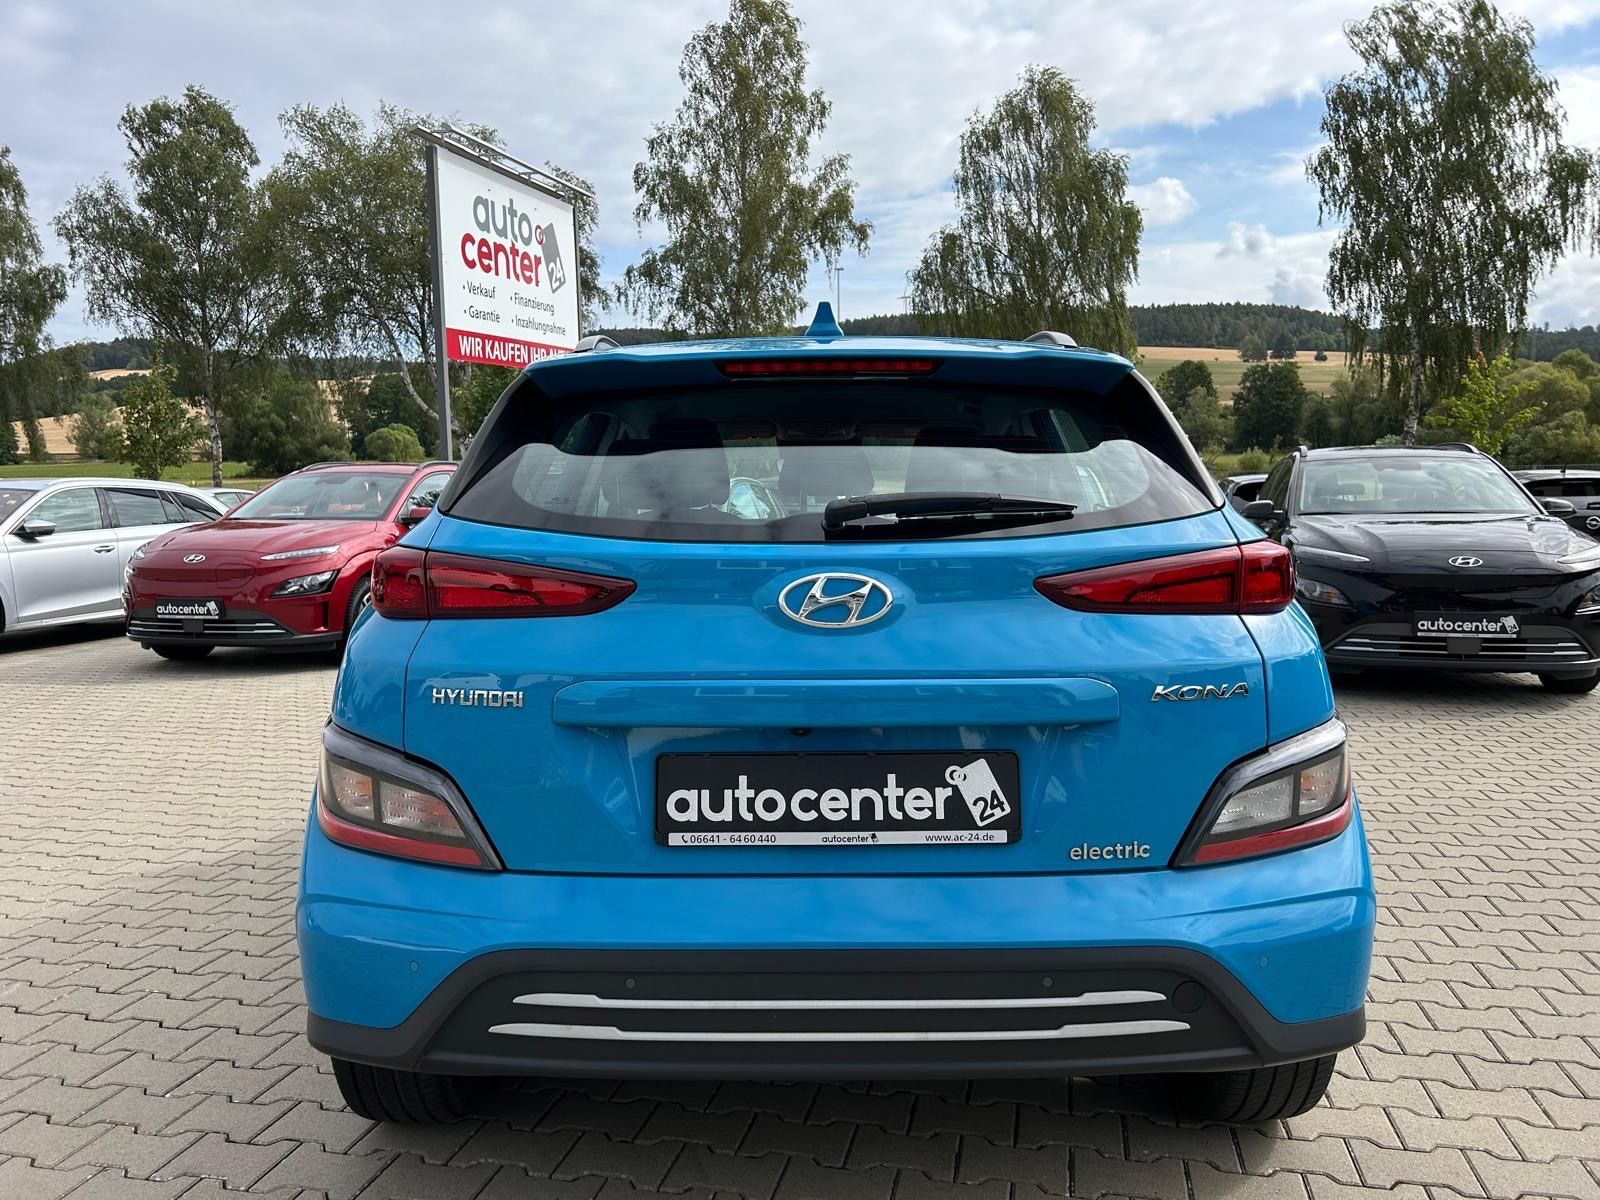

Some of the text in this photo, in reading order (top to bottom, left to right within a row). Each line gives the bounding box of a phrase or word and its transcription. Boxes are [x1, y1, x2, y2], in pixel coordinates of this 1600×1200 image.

[473, 194, 533, 246] auto
[461, 233, 542, 287] center
[549, 259, 563, 286] 24
[467, 280, 496, 299] Verkauf
[468, 305, 500, 323] Garantie
[514, 292, 555, 316] Finanzierung
[515, 315, 566, 336] Inzahlungnahme
[458, 335, 483, 358] WIR
[485, 339, 528, 364] KAUFEN
[156, 603, 208, 614] autocenter
[1417, 617, 1503, 632] autocenter
[432, 688, 524, 708] HYUNDAI
[1150, 682, 1249, 702] KONA
[666, 773, 1006, 822] autocenter 24
[690, 834, 720, 844] 06641
[821, 834, 869, 843] autocenter
[924, 833, 995, 843] www.ac-24.de
[1069, 840, 1151, 860] electric
